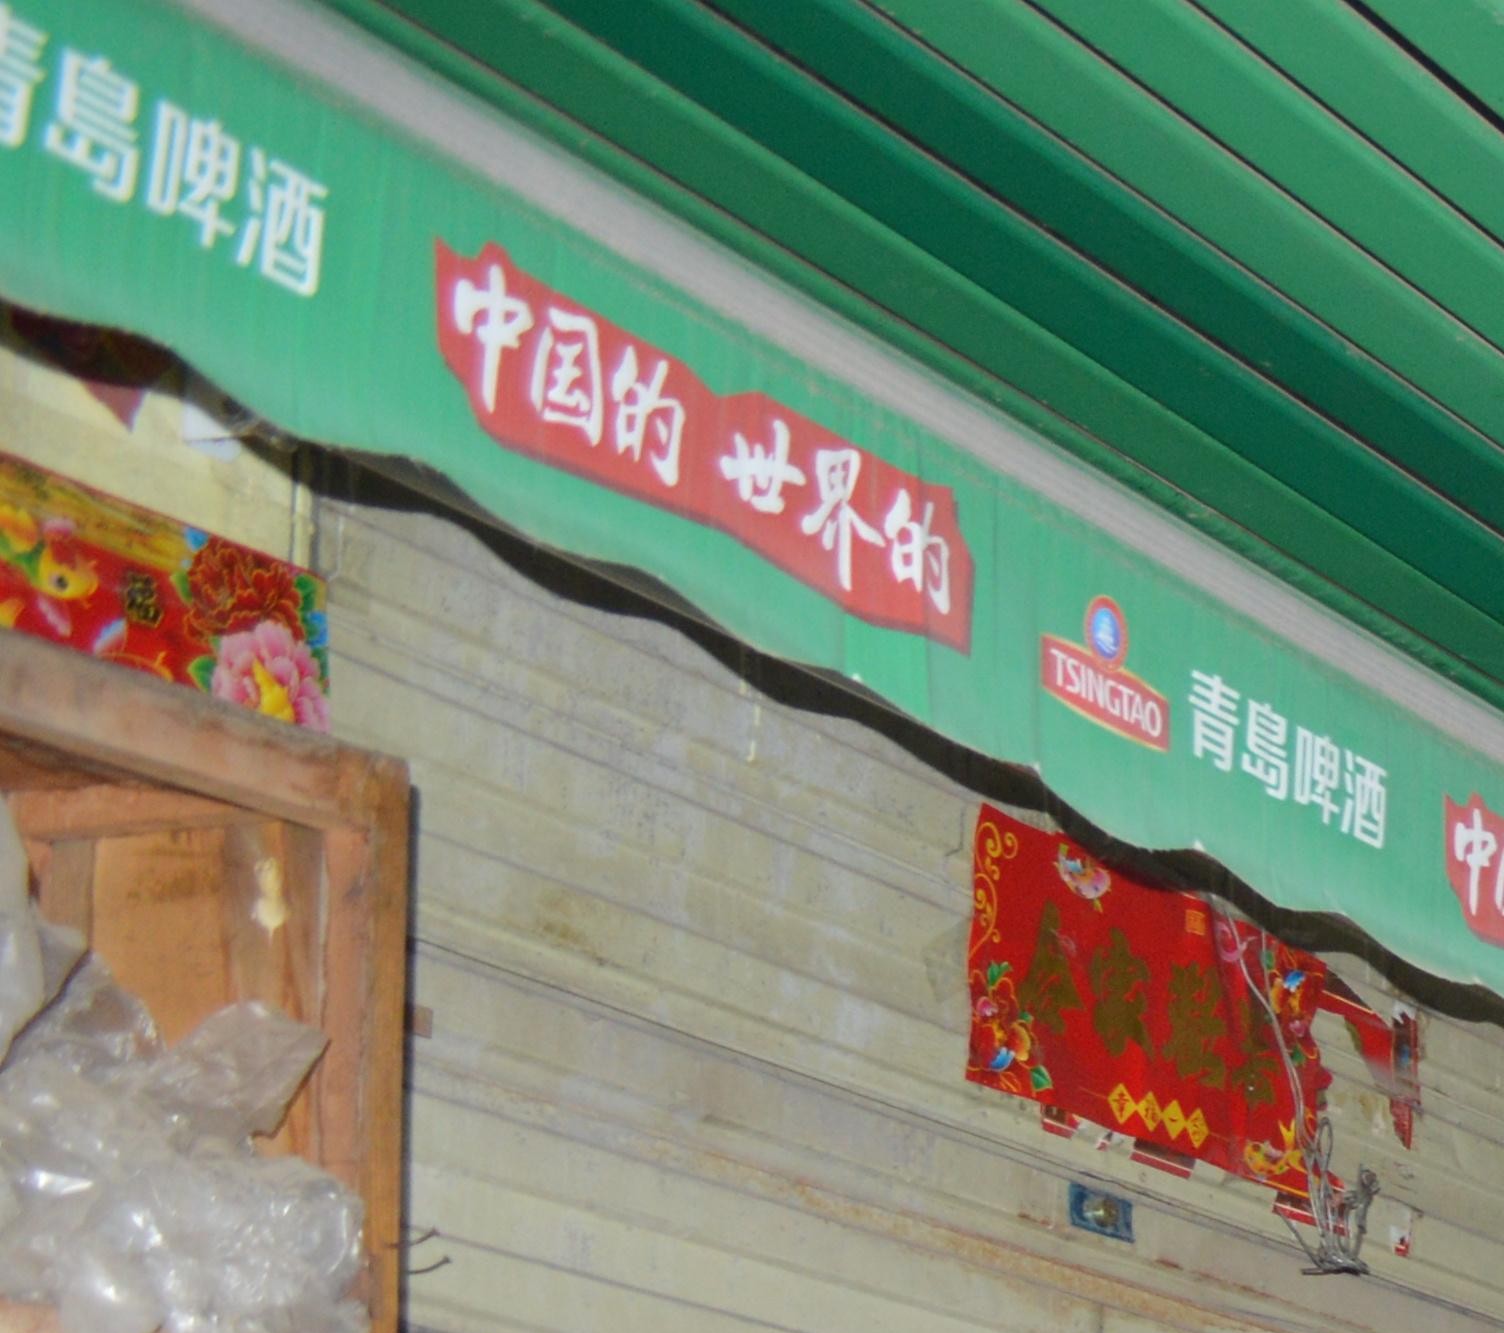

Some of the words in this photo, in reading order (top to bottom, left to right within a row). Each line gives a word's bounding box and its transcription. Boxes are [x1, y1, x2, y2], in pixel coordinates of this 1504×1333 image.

[454, 264, 683, 487] 中国的
[720, 420, 951, 614] 世界的
[1050, 649, 1163, 738] TSINGTAO
